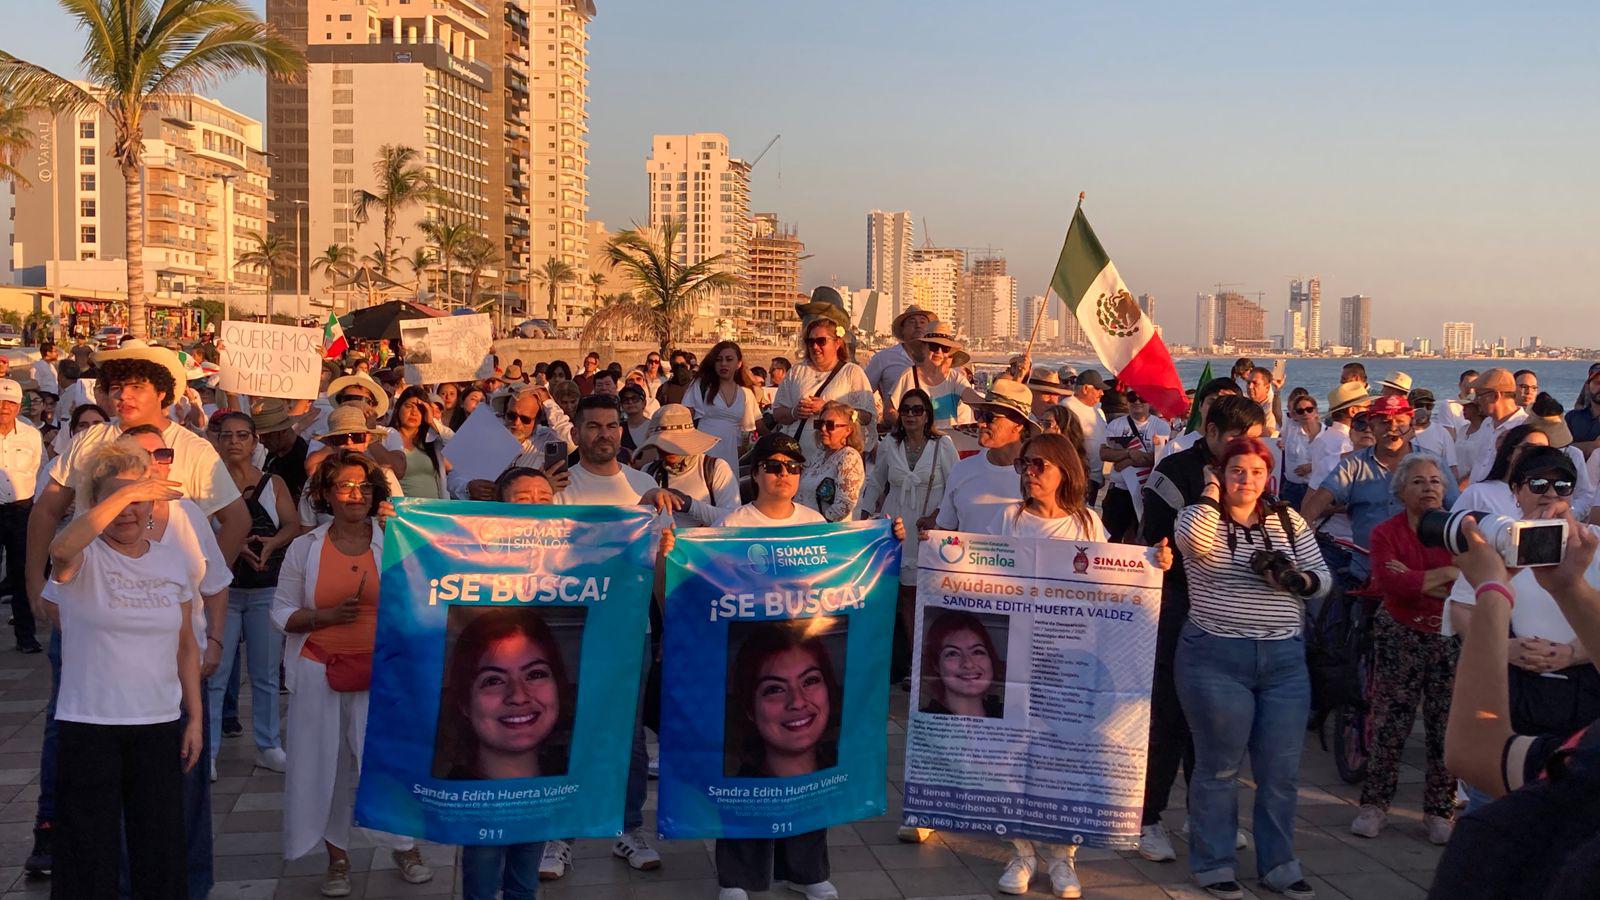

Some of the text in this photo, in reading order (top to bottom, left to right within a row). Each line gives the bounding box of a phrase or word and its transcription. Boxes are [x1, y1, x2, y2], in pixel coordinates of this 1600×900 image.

[38, 121, 50, 166] VARALI
[226, 326, 320, 353] QUEREMOS
[225, 349, 311, 374] VIVIR SIN
[236, 371, 294, 393] MIEDO
[513, 538, 571, 549] SINALOA
[776, 544, 828, 556] SÚMATE
[778, 556, 829, 567] SINALOA
[968, 552, 1015, 568] Sinaloa
[1093, 556, 1145, 569] SINALOA
[429, 574, 611, 606] ¡SE BUSCA!
[940, 576, 1142, 605] Ayúdanos a encontrar a
[710, 586, 866, 622] ¡SE BUSCA!
[942, 594, 1134, 622] SANDRA EDITH HUERTA VALDEZ
[413, 783, 459, 801] Sandra
[462, 790, 495, 801] Edith
[498, 789, 540, 800] Huerta
[543, 784, 579, 797] Valdez
[708, 785, 750, 798] Sandra
[752, 786, 783, 797] Edith
[785, 781, 819, 797] Huerta
[820, 773, 849, 788] Valdez
[909, 786, 919, 795] Si
[923, 788, 951, 798] tienes
[956, 792, 1012, 805] información
[1016, 797, 1058, 811] referente
[1061, 804, 1068, 812] a
[1072, 806, 1093, 815] esta
[909, 796, 933, 807] llama
[1002, 805, 1014, 815] Tu
[1015, 809, 1043, 820] ayuda
[1046, 812, 1058, 820] es
[1060, 814, 1082, 826] muy
[478, 828, 504, 840] 911
[772, 821, 793, 834] 911
[932, 816, 954, 829] (669)
